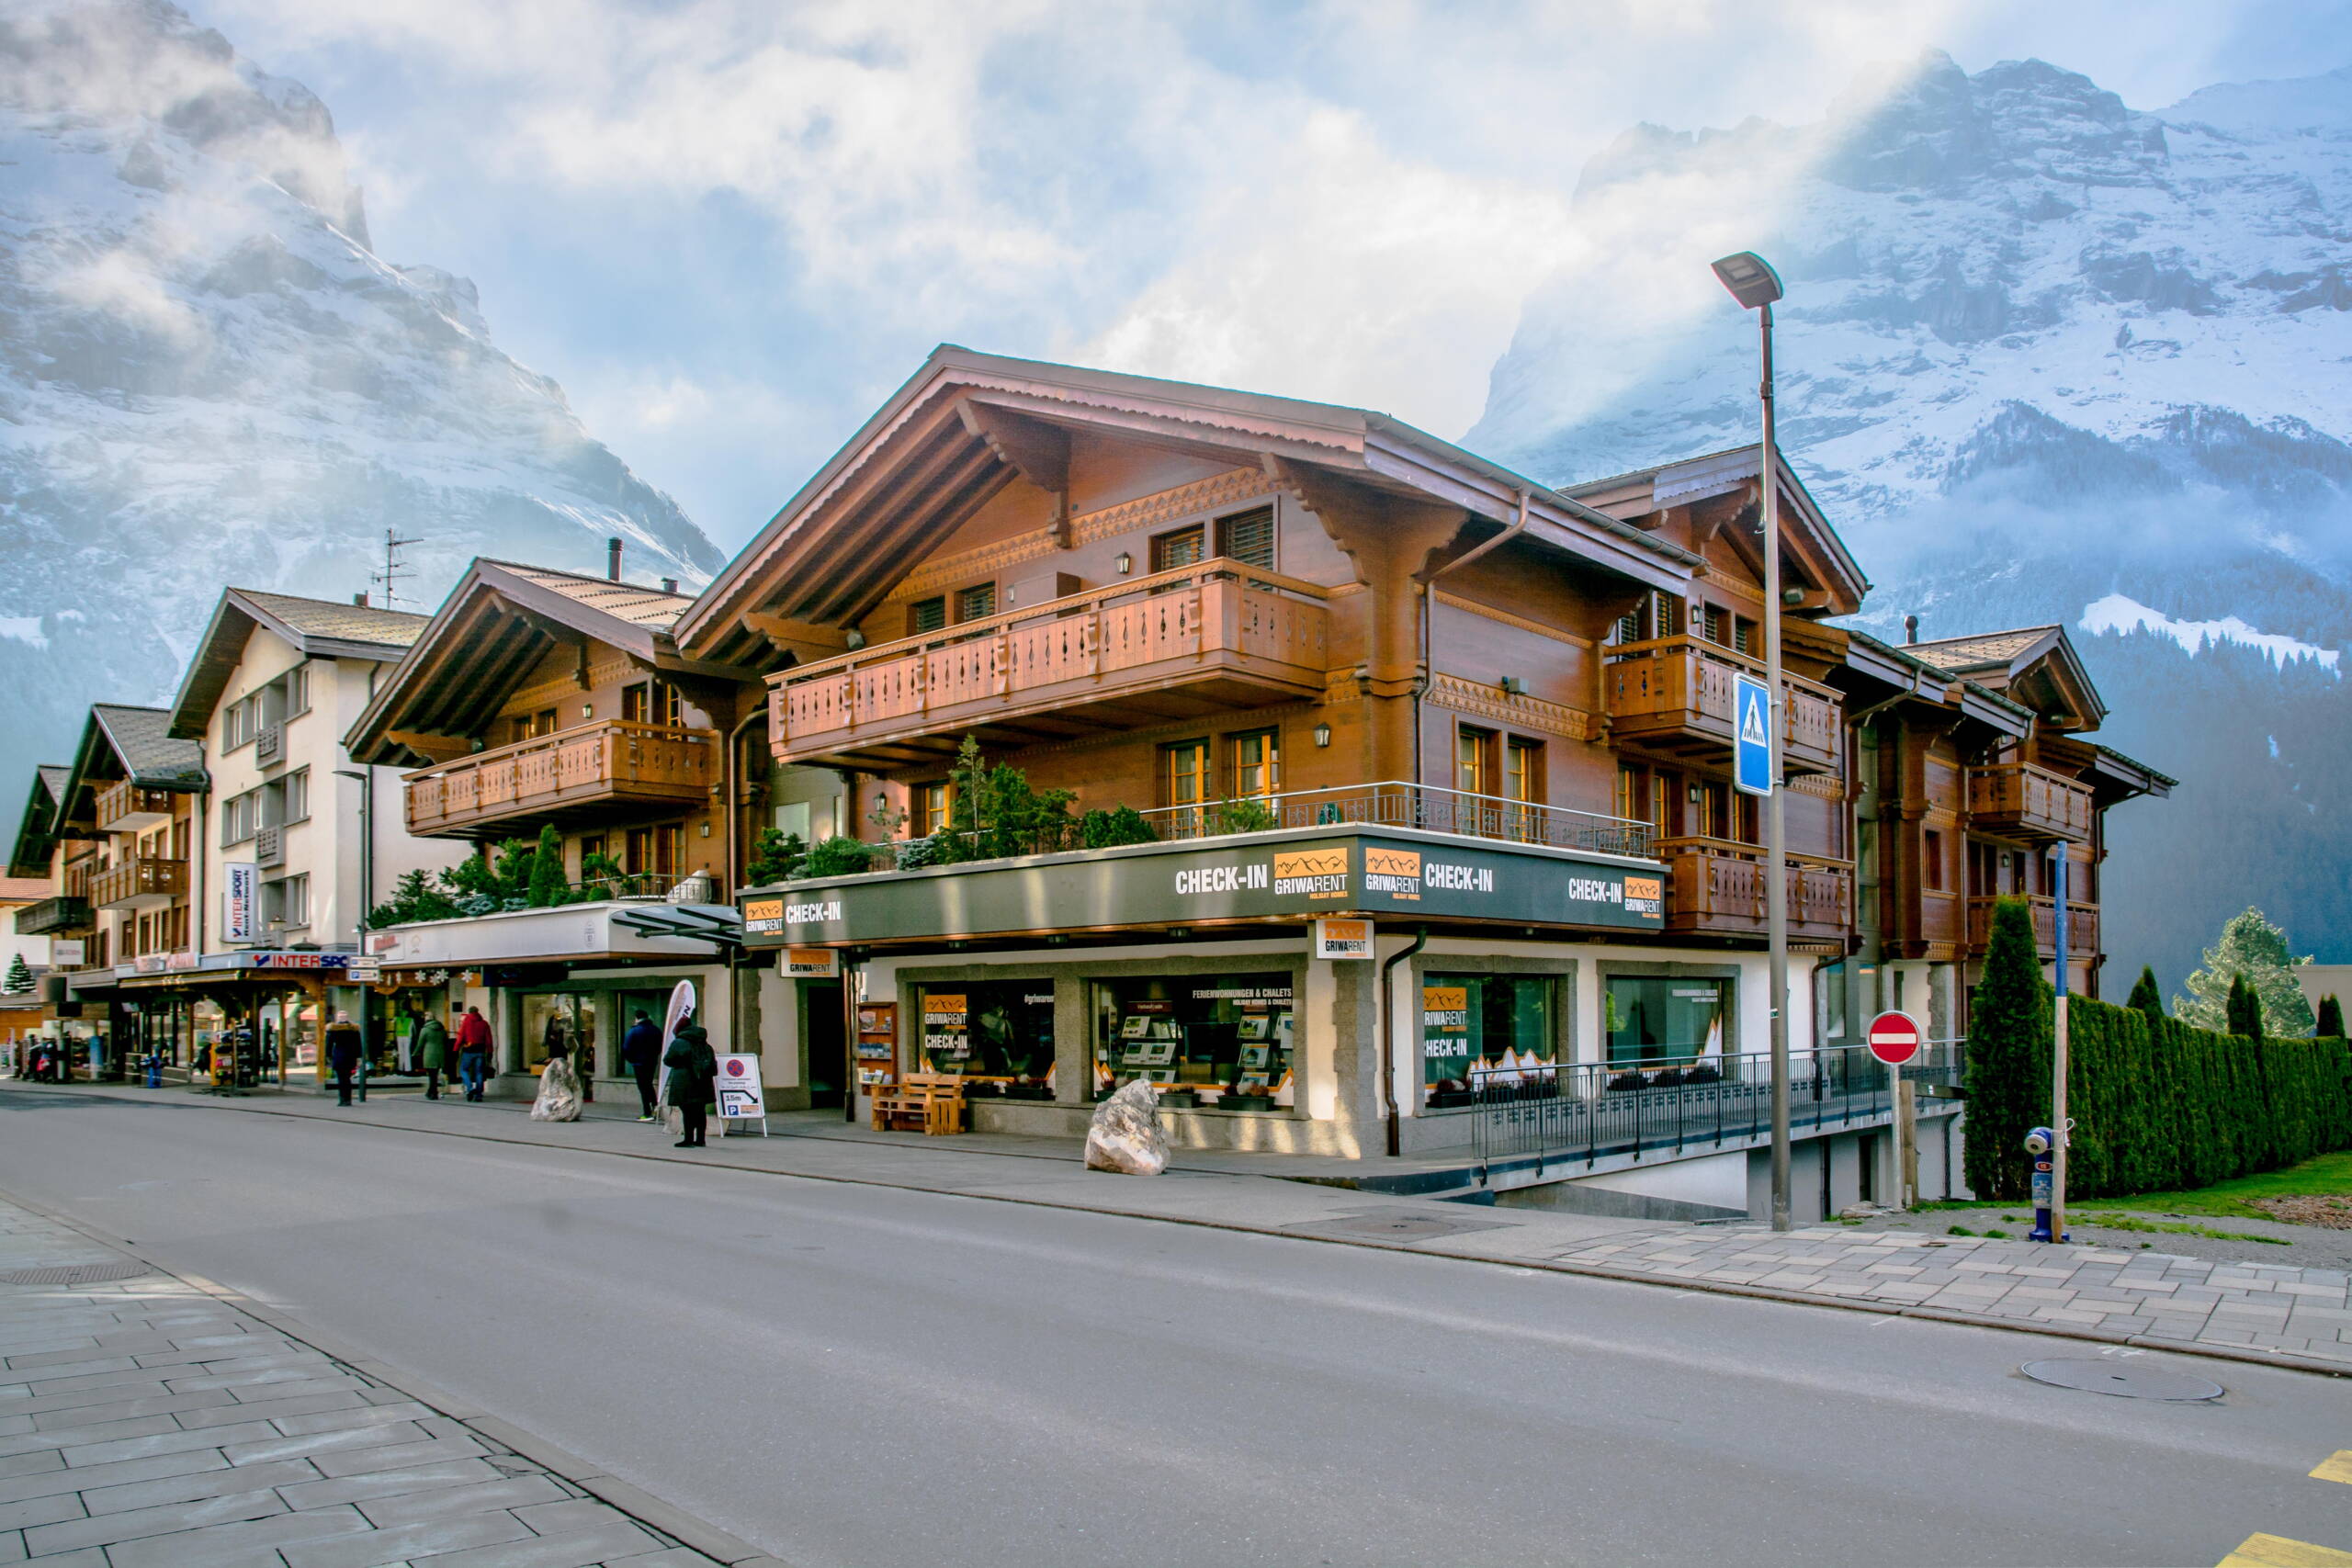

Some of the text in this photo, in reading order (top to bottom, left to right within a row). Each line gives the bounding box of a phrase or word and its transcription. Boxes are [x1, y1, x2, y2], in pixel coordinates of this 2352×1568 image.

[1175, 864, 1268, 895] CHECK-IN
[1274, 874, 1348, 895] GRIWARENT
[1365, 874, 1420, 894] GRIWARENT
[1425, 863, 1493, 892] CHECK-IN
[232, 869, 243, 927] INTERSPORT
[1568, 877, 1622, 904] CHECK-IN
[1624, 897, 1660, 912] GRIWARENT
[786, 901, 842, 924] CHECK-IN
[746, 919, 783, 932] GRIWARENT
[1325, 940, 1366, 952] GRIWARENT
[273, 955, 347, 967] INTERSPO
[790, 964, 831, 973] GRIWARENT
[1023, 993, 1055, 1005] #griwaren
[1193, 988, 1292, 998] FERIENWOHNUNGEN & CHALETS
[924, 1013, 967, 1024] GRIWARENT
[1424, 1011, 1467, 1026] RIWARENT
[924, 1034, 967, 1049] CHECK-IN
[1424, 1038, 1467, 1057] HECK-IN
